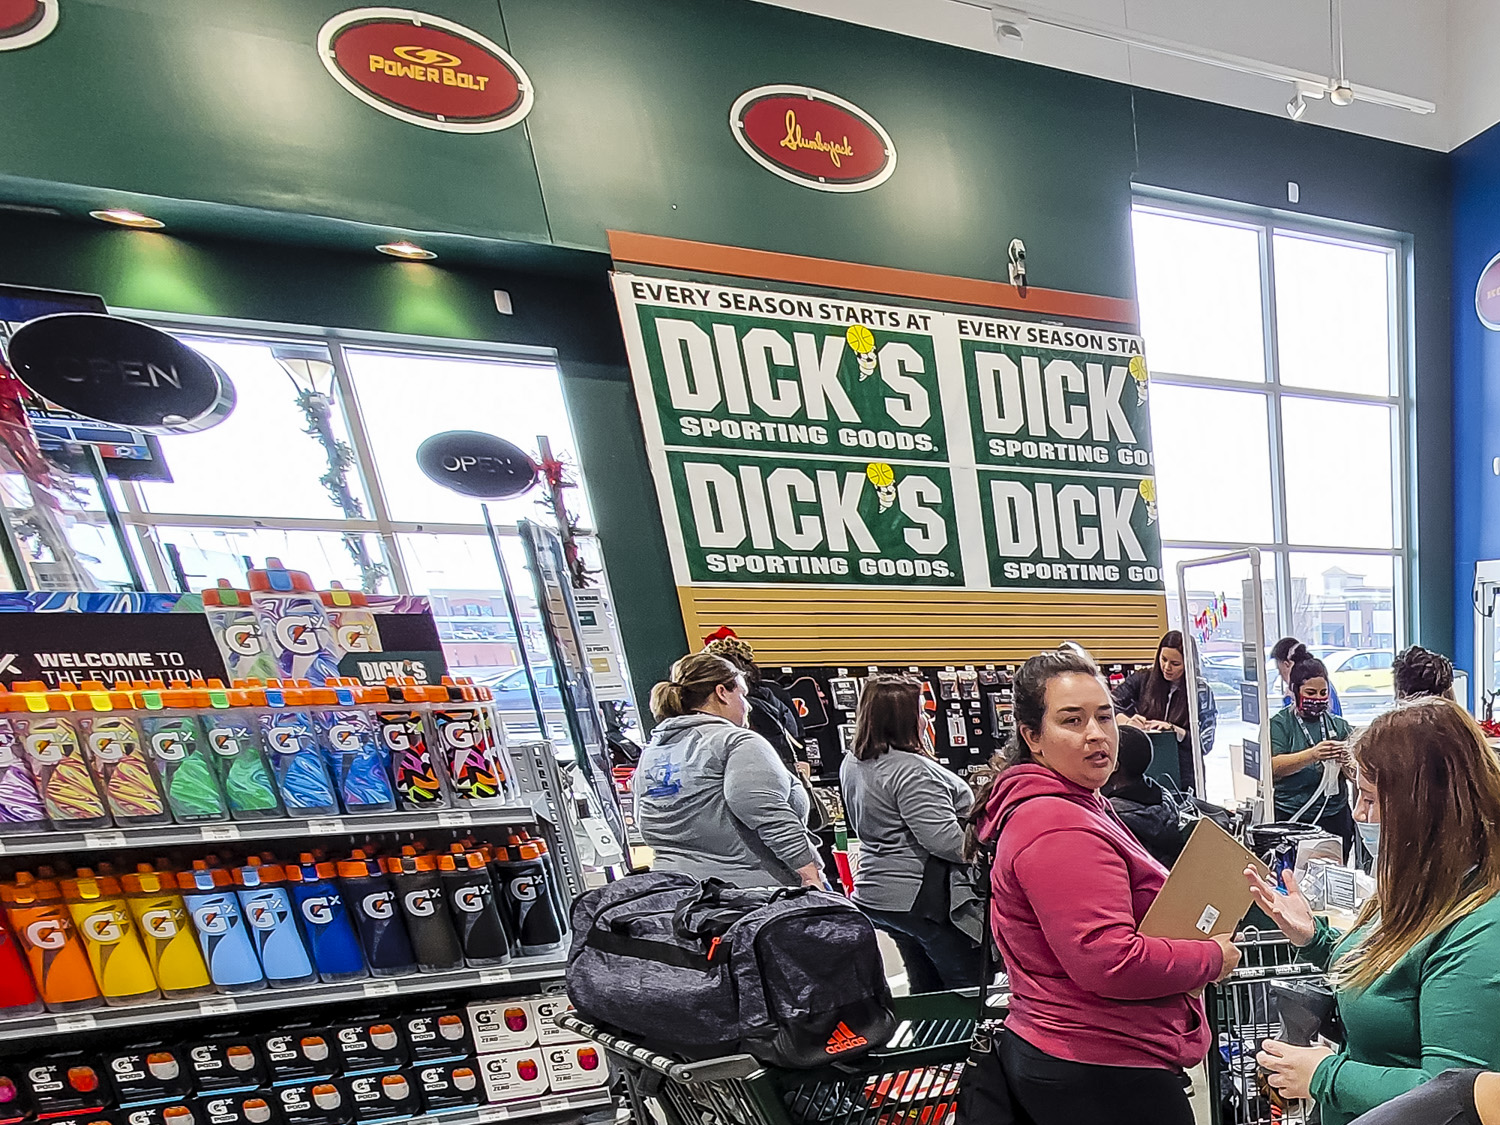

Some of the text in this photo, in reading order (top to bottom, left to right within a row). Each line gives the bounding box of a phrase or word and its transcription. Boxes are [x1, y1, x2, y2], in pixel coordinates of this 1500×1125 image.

[369, 54, 489, 92] POWER BOLT
[631, 281, 932, 331] EVERY SEASON STARTS AT
[958, 319, 1021, 341] EVERY
[1027, 327, 1103, 350] SEASON
[654, 317, 932, 428] DICK'S
[679, 416, 829, 445] SPORTING
[989, 439, 1109, 464] SPORTING
[683, 461, 948, 555] DICK'S
[705, 553, 849, 575] SPORTING
[1003, 562, 1120, 581] SPORTING
[34, 652, 184, 668] WELCOME TO
[357, 660, 428, 681] DICK'S
[41, 668, 203, 685] THE EVOLUTION
[825, 1036, 868, 1054] adidas
